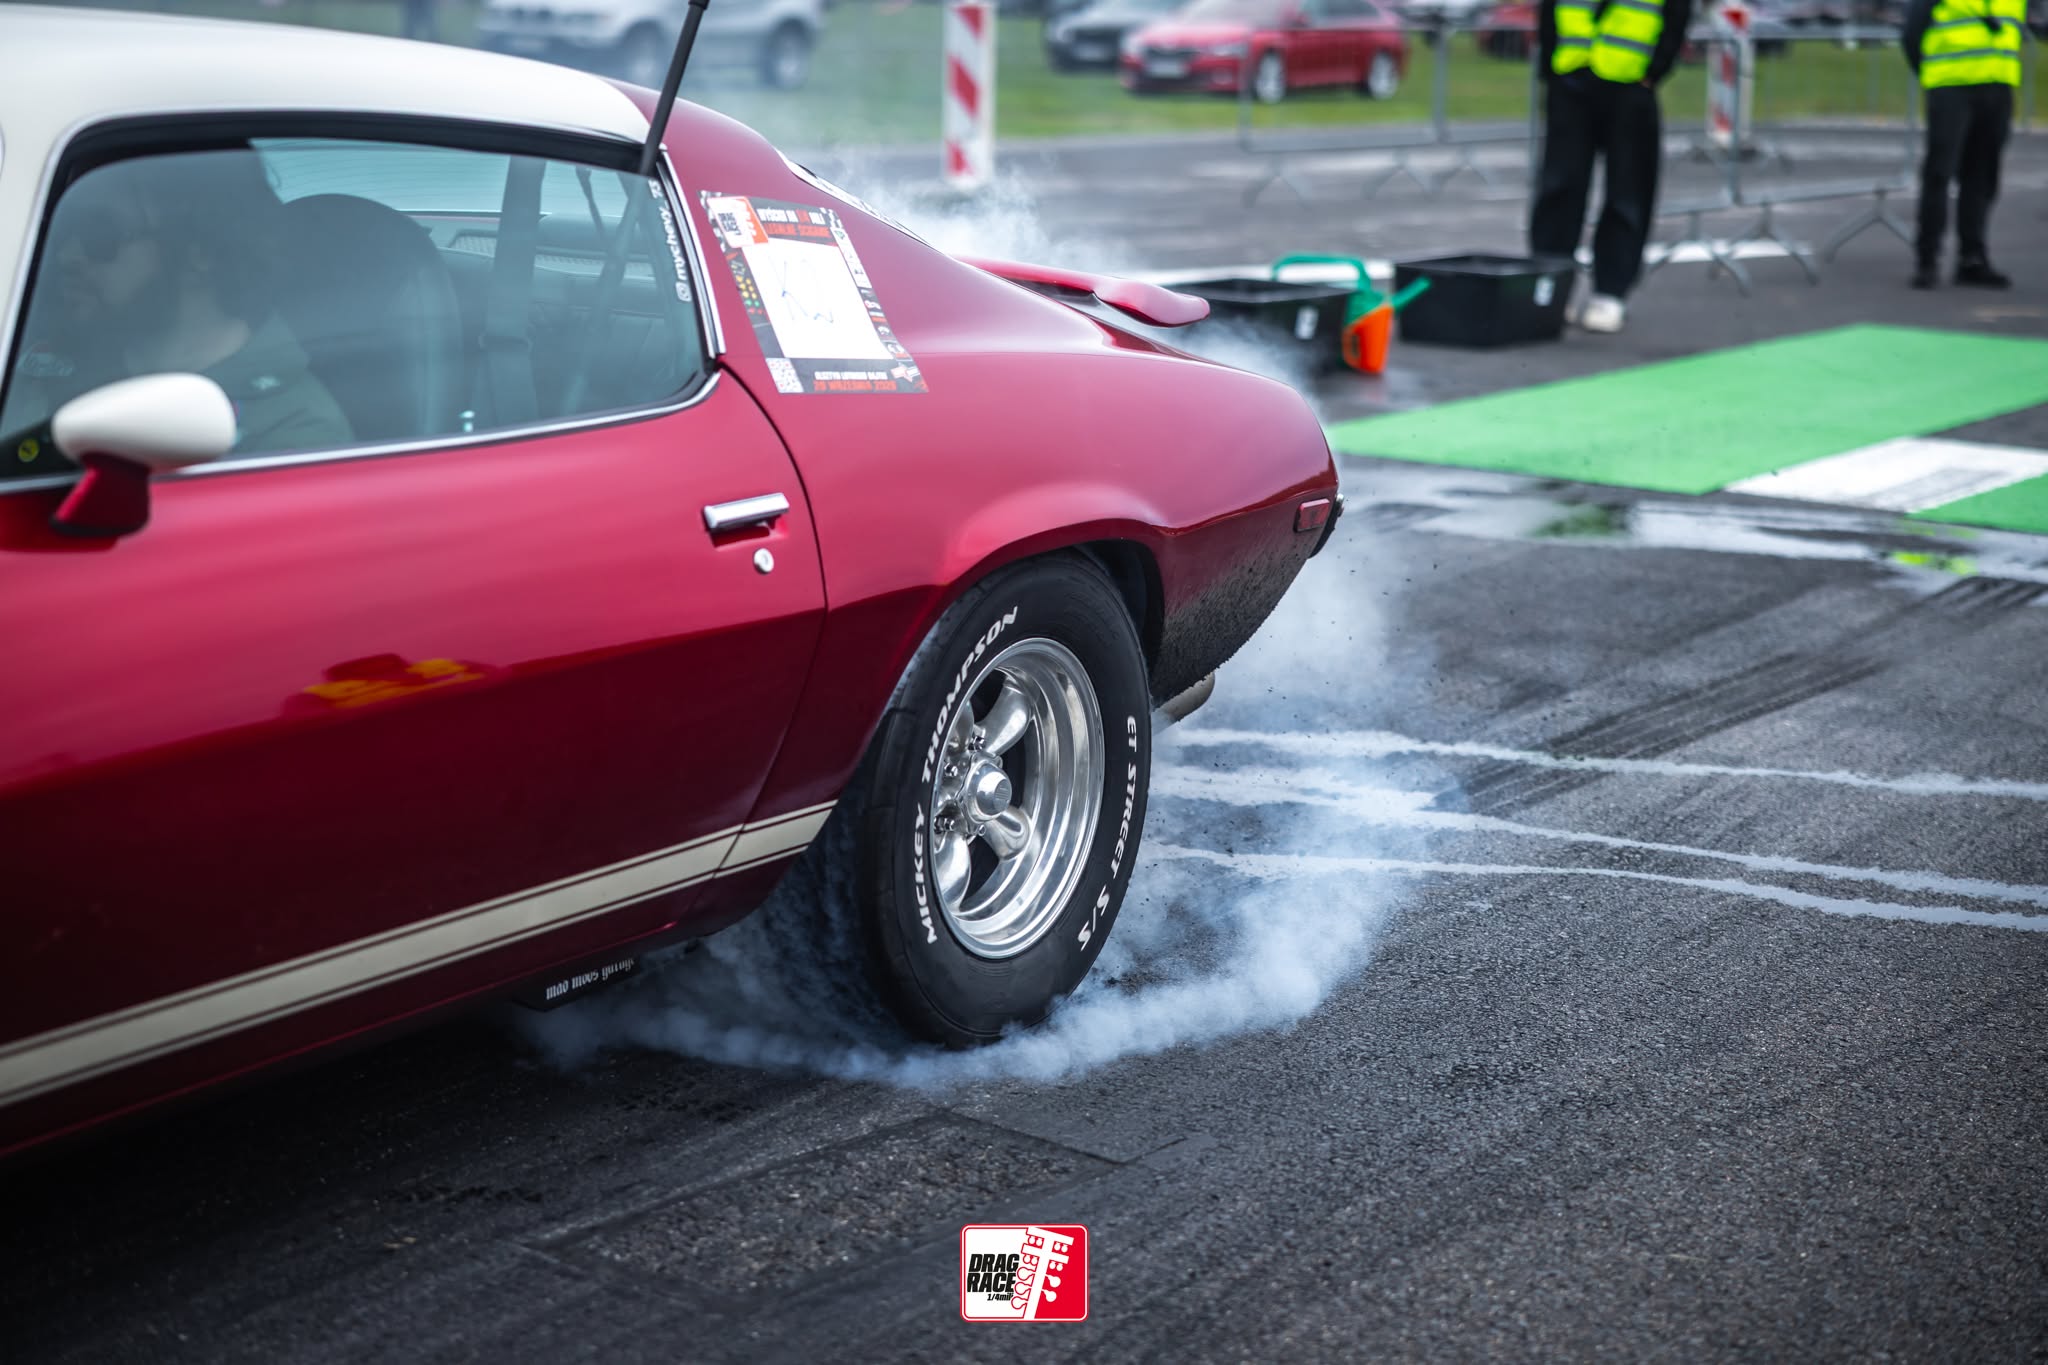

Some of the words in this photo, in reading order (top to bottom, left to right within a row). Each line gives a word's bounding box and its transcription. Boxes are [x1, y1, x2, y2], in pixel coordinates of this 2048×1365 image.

[921, 605, 1018, 784] THOMPSON
[1126, 715, 1138, 753] ET
[914, 802, 938, 944] MICKEY
[1113, 762, 1137, 880] STREET
[1077, 884, 1111, 952] S/S
